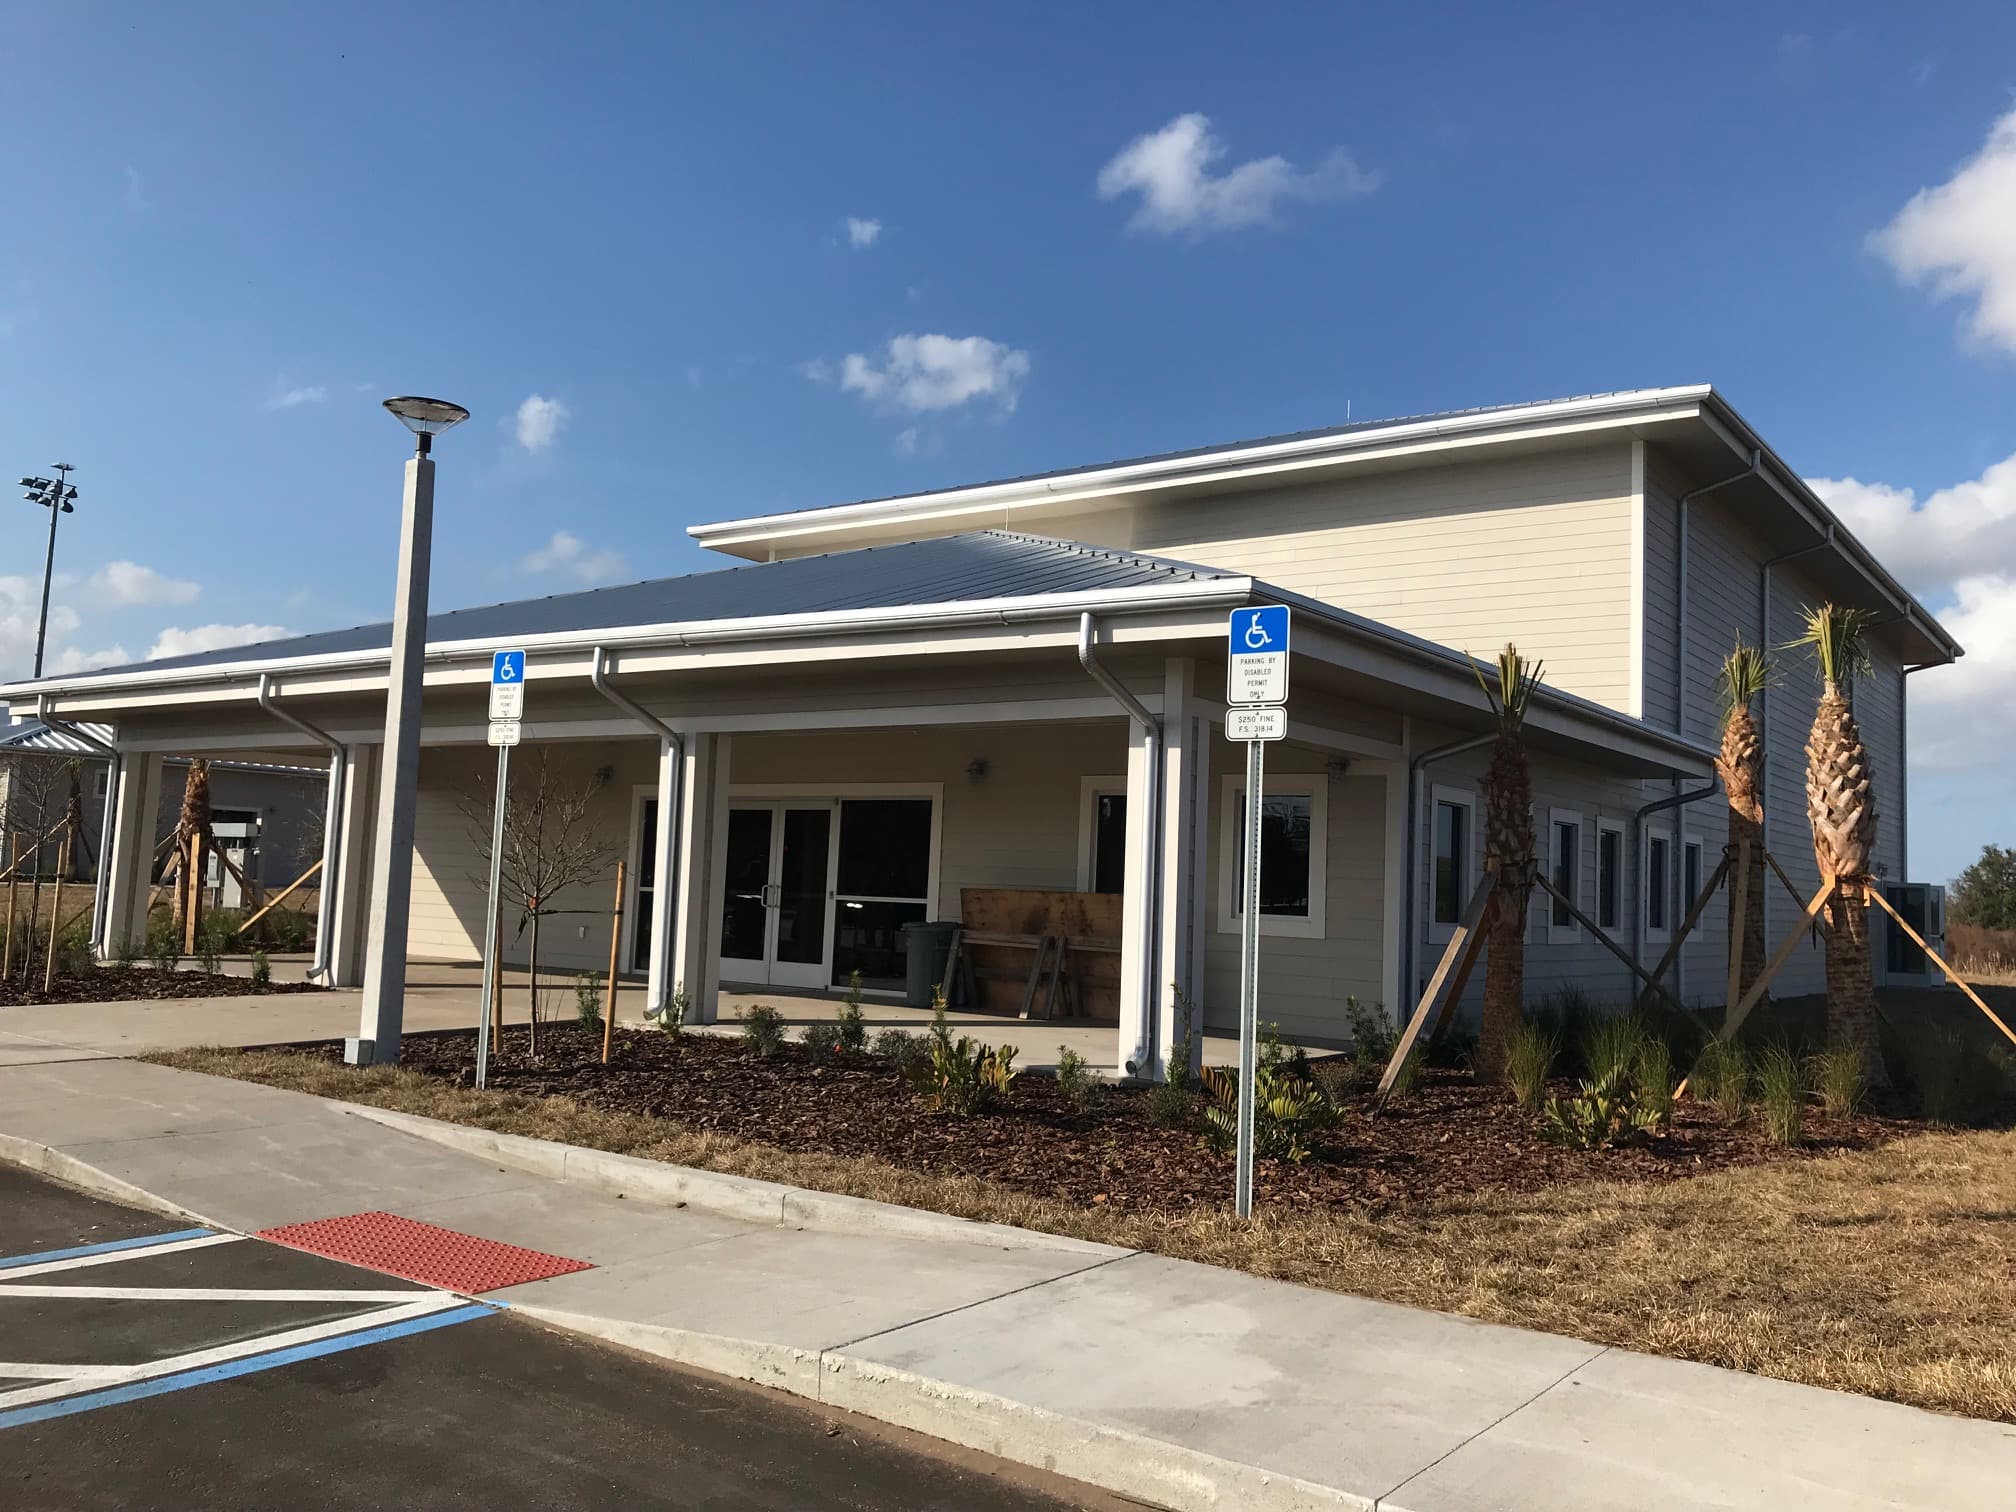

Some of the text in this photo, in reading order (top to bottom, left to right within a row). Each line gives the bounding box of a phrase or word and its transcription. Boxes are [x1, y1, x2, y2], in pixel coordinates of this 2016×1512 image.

[1240, 657, 1265, 665] PARKING
[1244, 668, 1272, 676] DISABLED
[1247, 679, 1268, 687] PERMIT
[1238, 715, 1256, 724] $250
